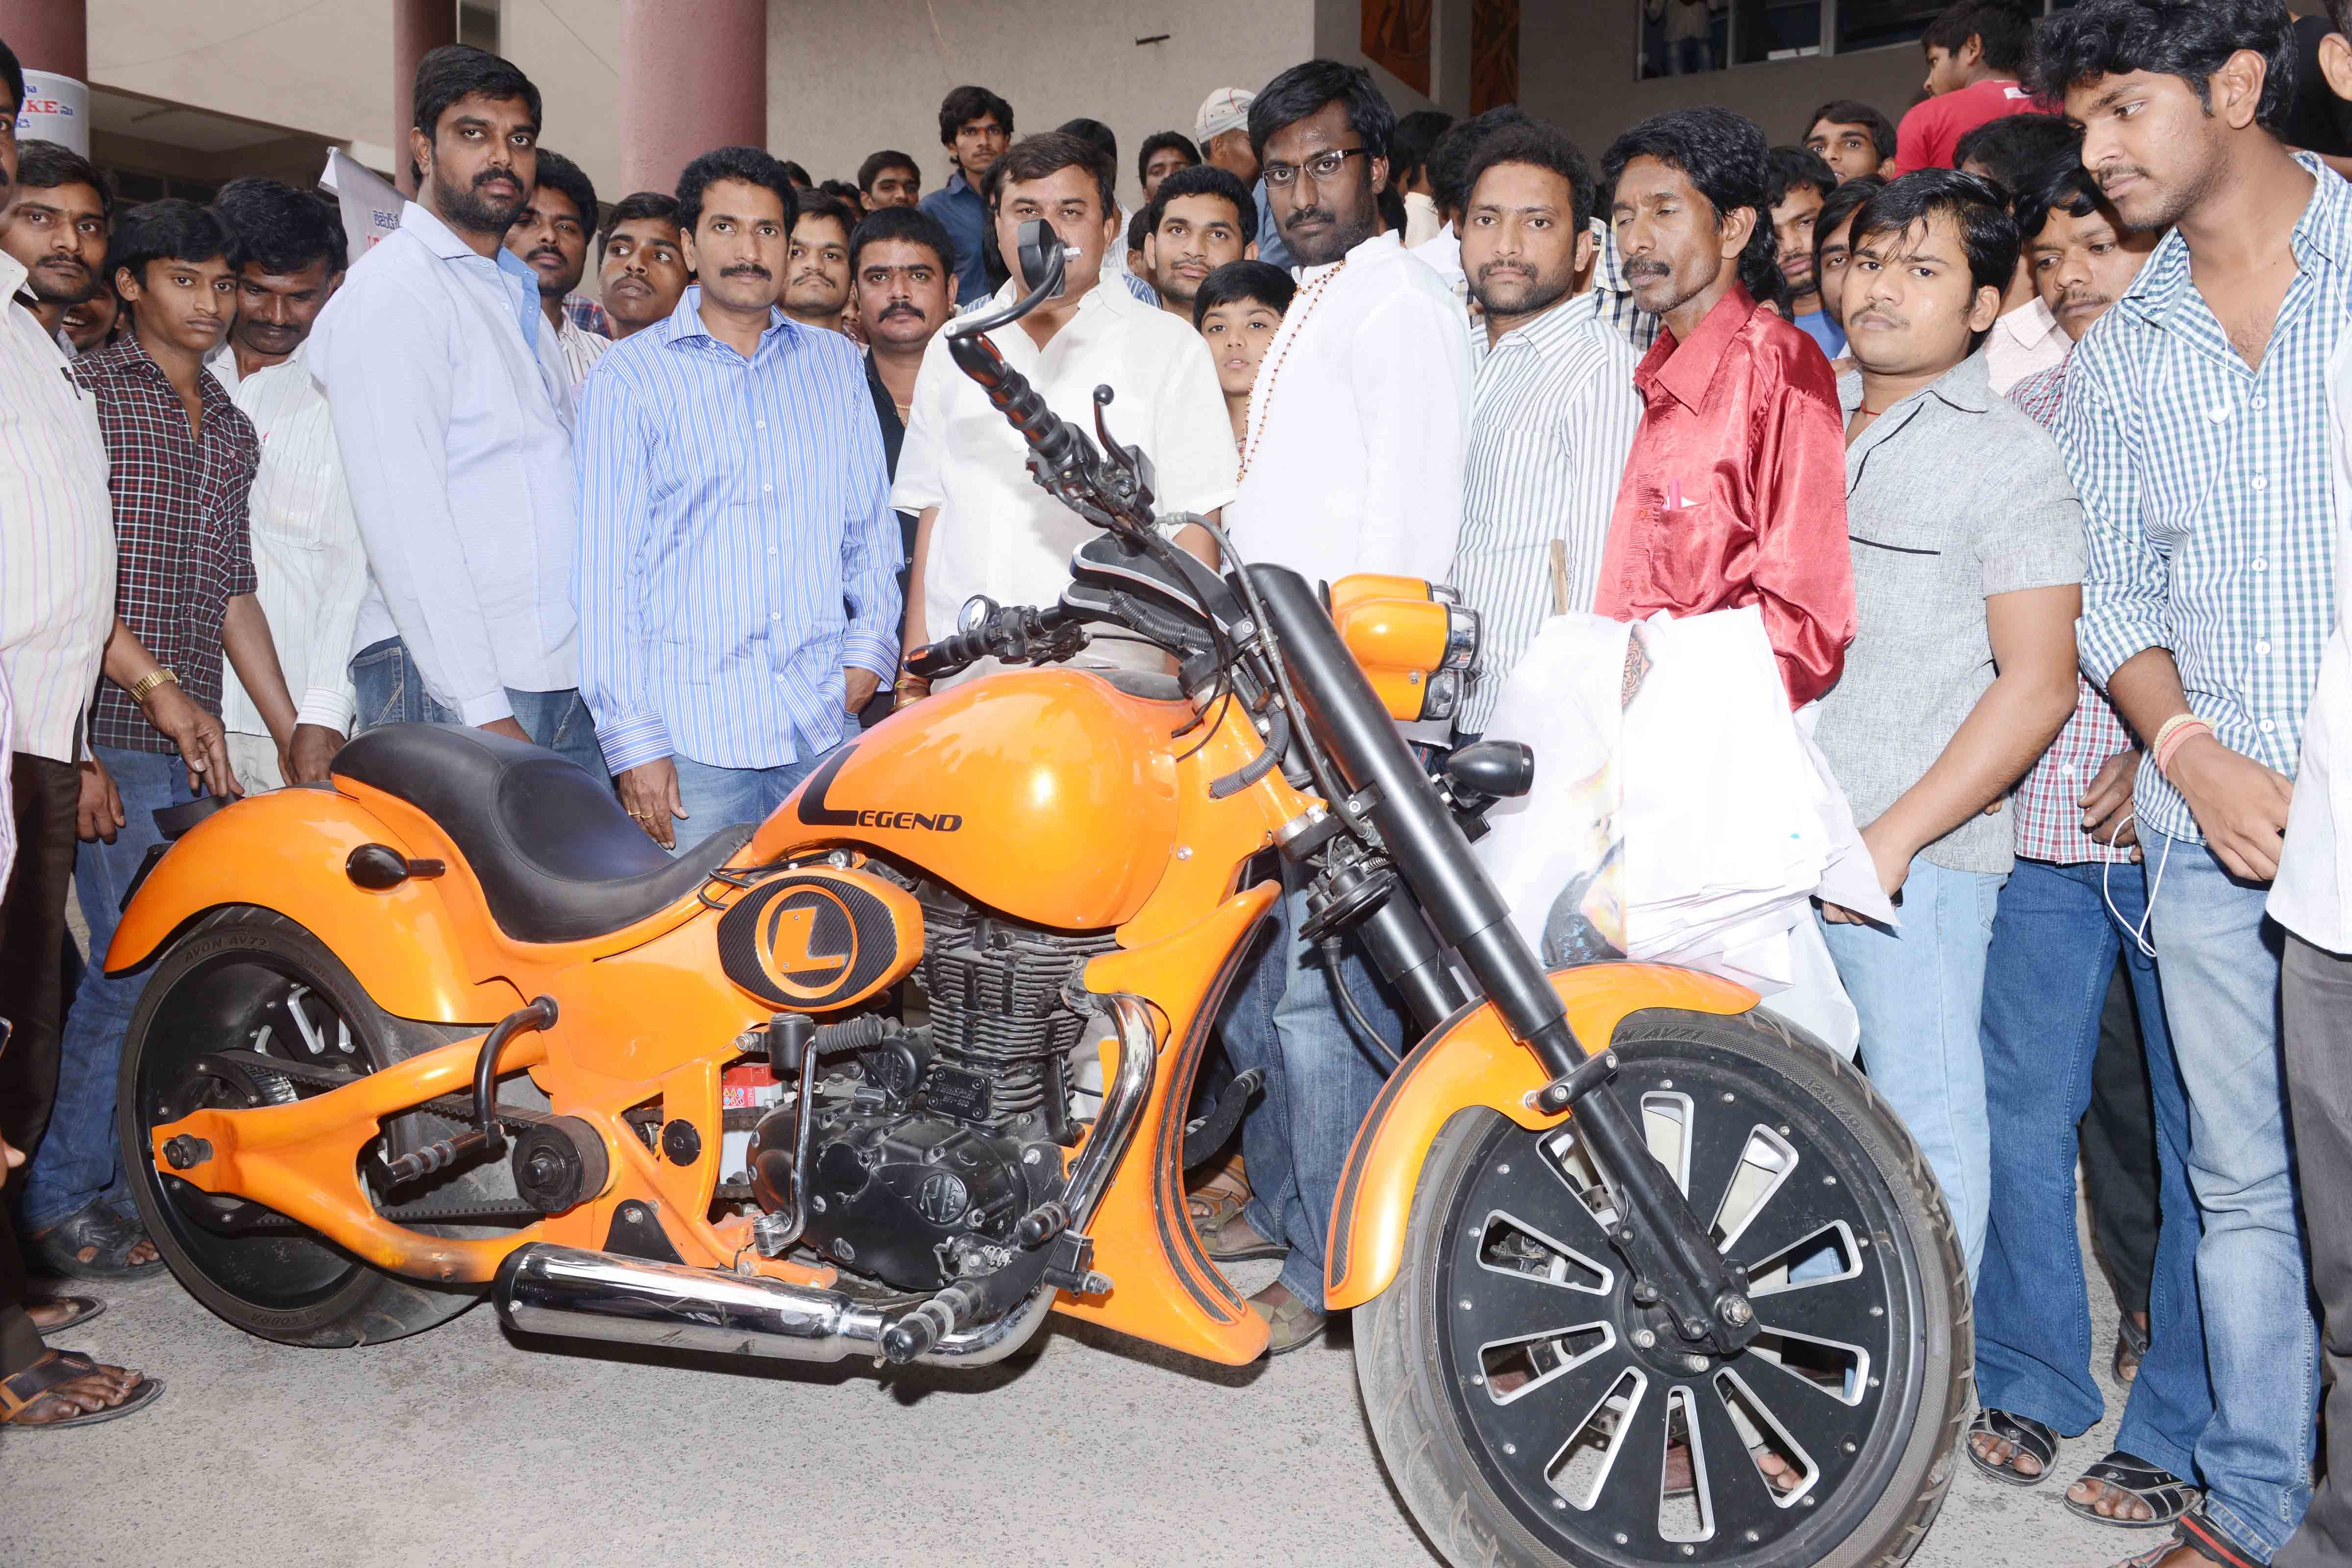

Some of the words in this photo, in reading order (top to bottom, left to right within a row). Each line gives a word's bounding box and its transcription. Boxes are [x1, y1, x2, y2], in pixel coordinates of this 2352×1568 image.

[21, 99, 58, 113] KE
[798, 743, 963, 832] LEGEND
[185, 936, 224, 963] AVON
[229, 936, 268, 947] AV72
[919, 1174, 965, 1223] RE
